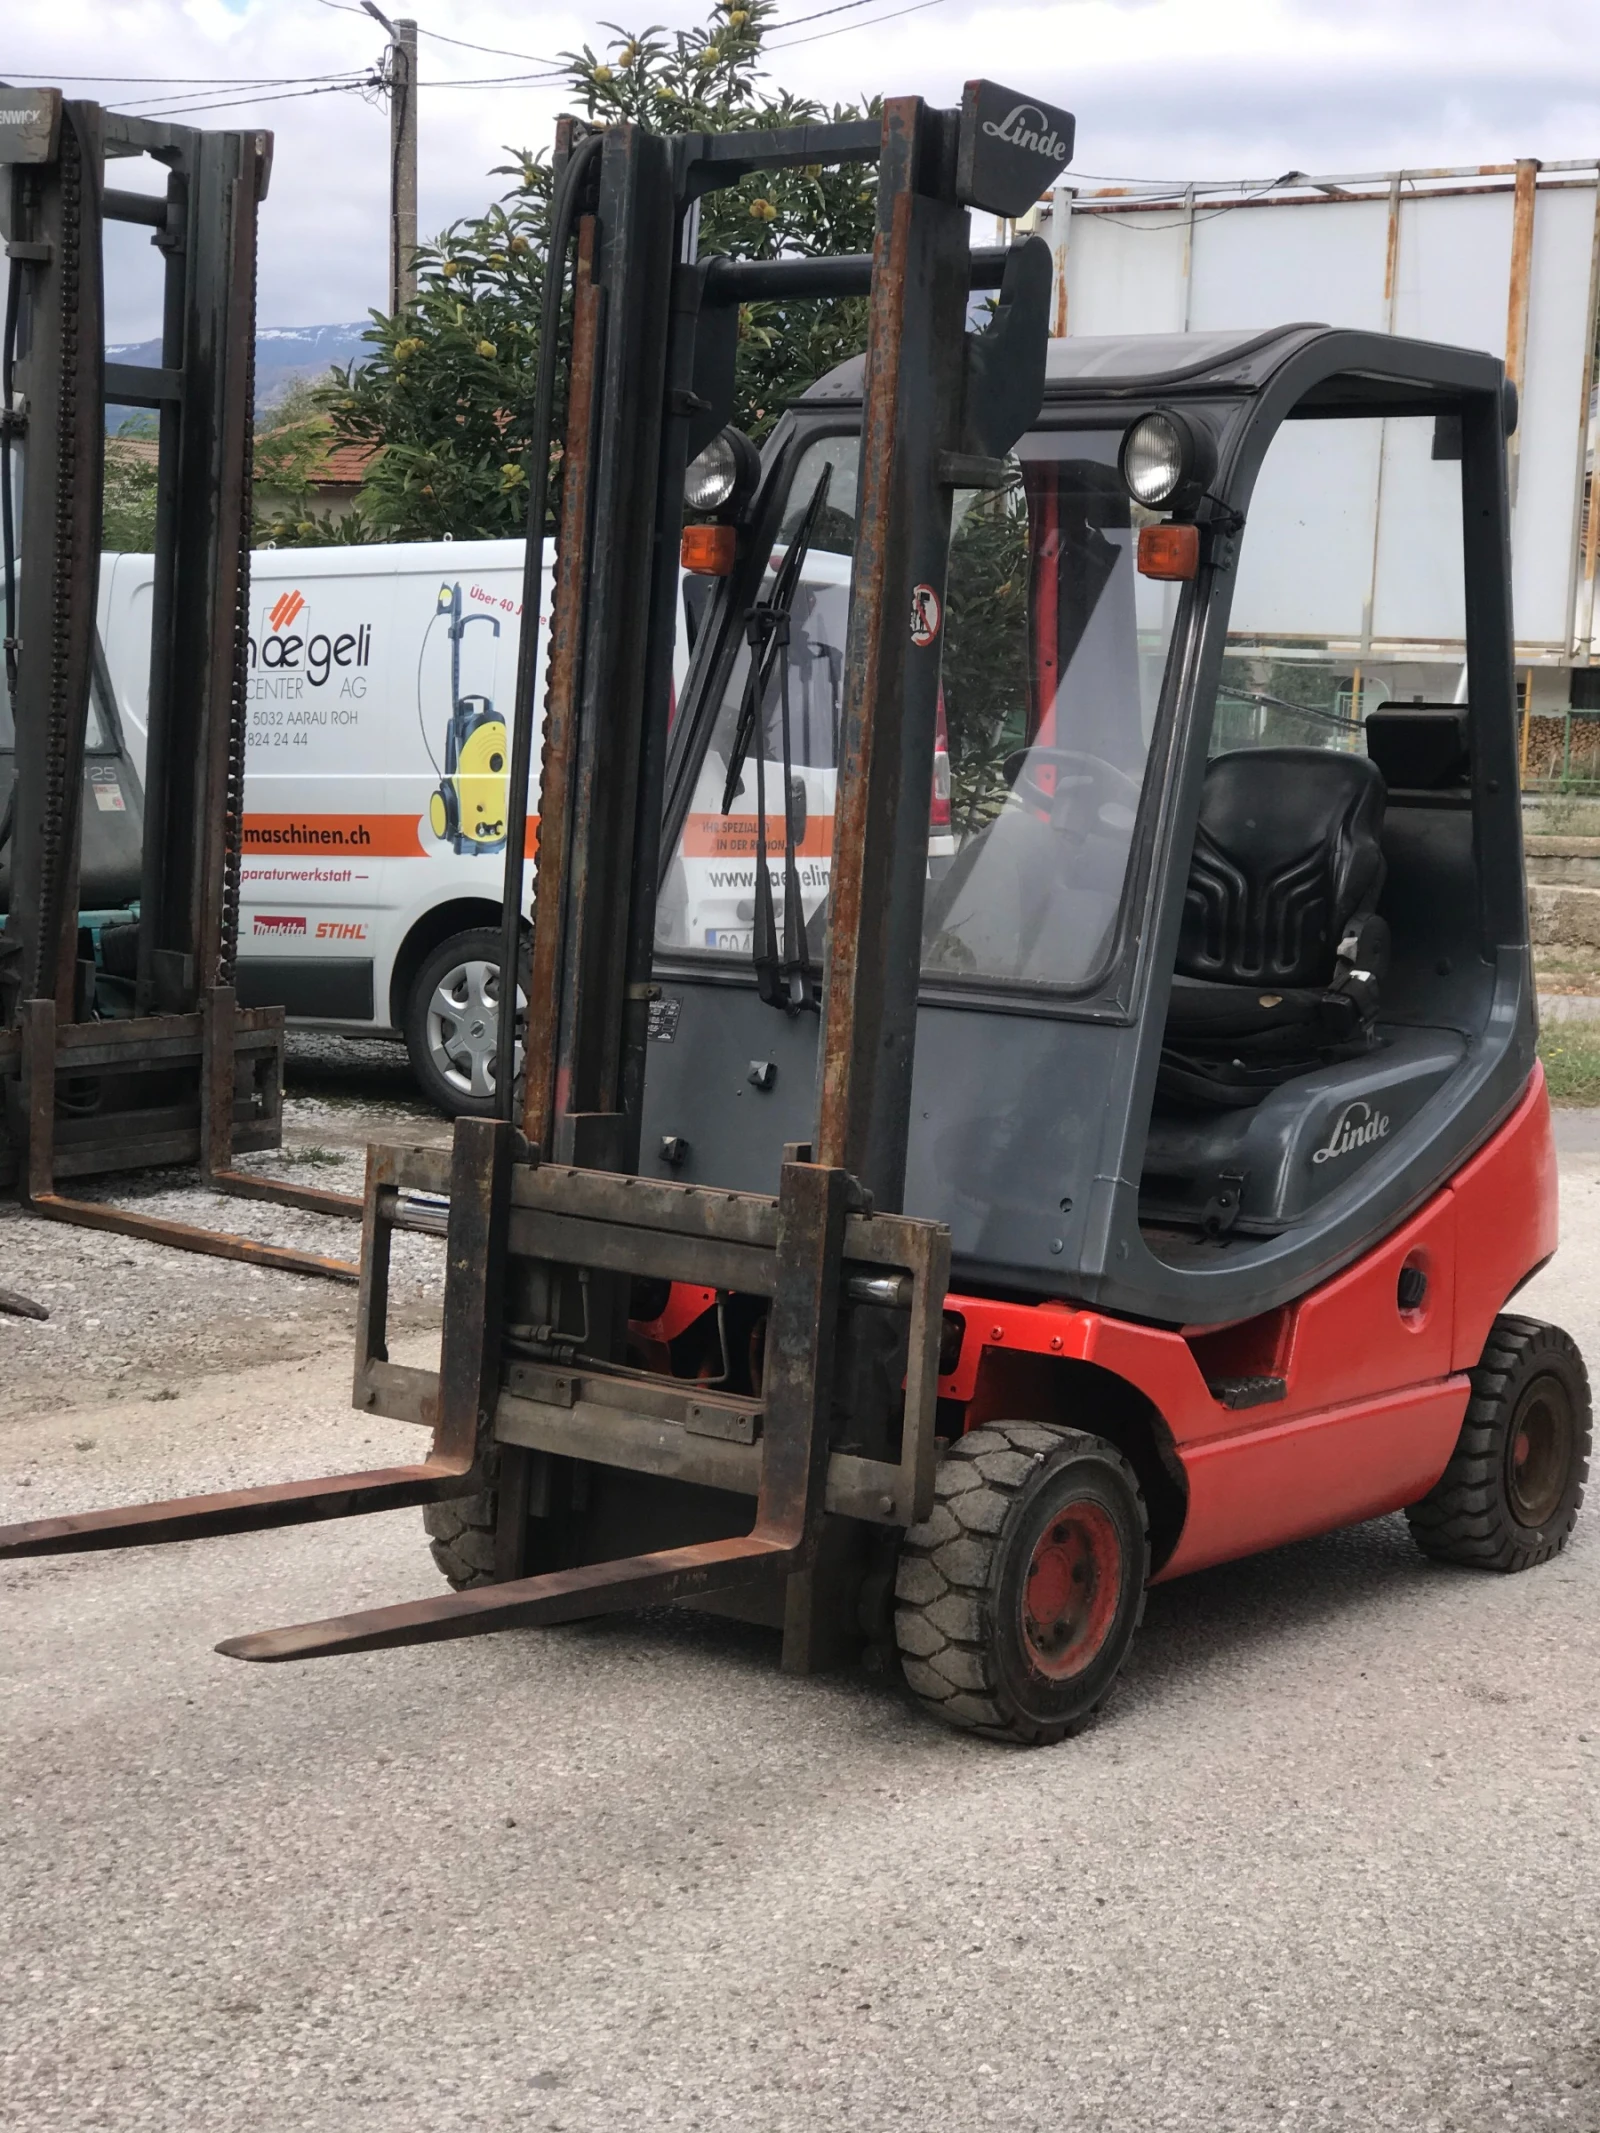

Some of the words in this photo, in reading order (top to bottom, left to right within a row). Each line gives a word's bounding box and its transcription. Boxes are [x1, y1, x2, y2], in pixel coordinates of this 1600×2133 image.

[982, 104, 1066, 161] Linde
[470, 583, 497, 605] Über
[500, 598, 514, 612] 40
[246, 677, 304, 699] CENTER
[339, 676, 367, 698] AG
[253, 711, 284, 726] 5032
[287, 710, 328, 725] AARAU
[331, 710, 358, 725] ROH
[247, 732, 270, 747] 824
[274, 732, 288, 746] 24
[293, 732, 308, 746] 44
[244, 823, 371, 845] maschinen.ch
[731, 839, 748, 851] DER
[241, 867, 352, 883] paraturwerkstatt
[315, 923, 366, 940] STIHL
[1313, 1101, 1390, 1164] Linde
